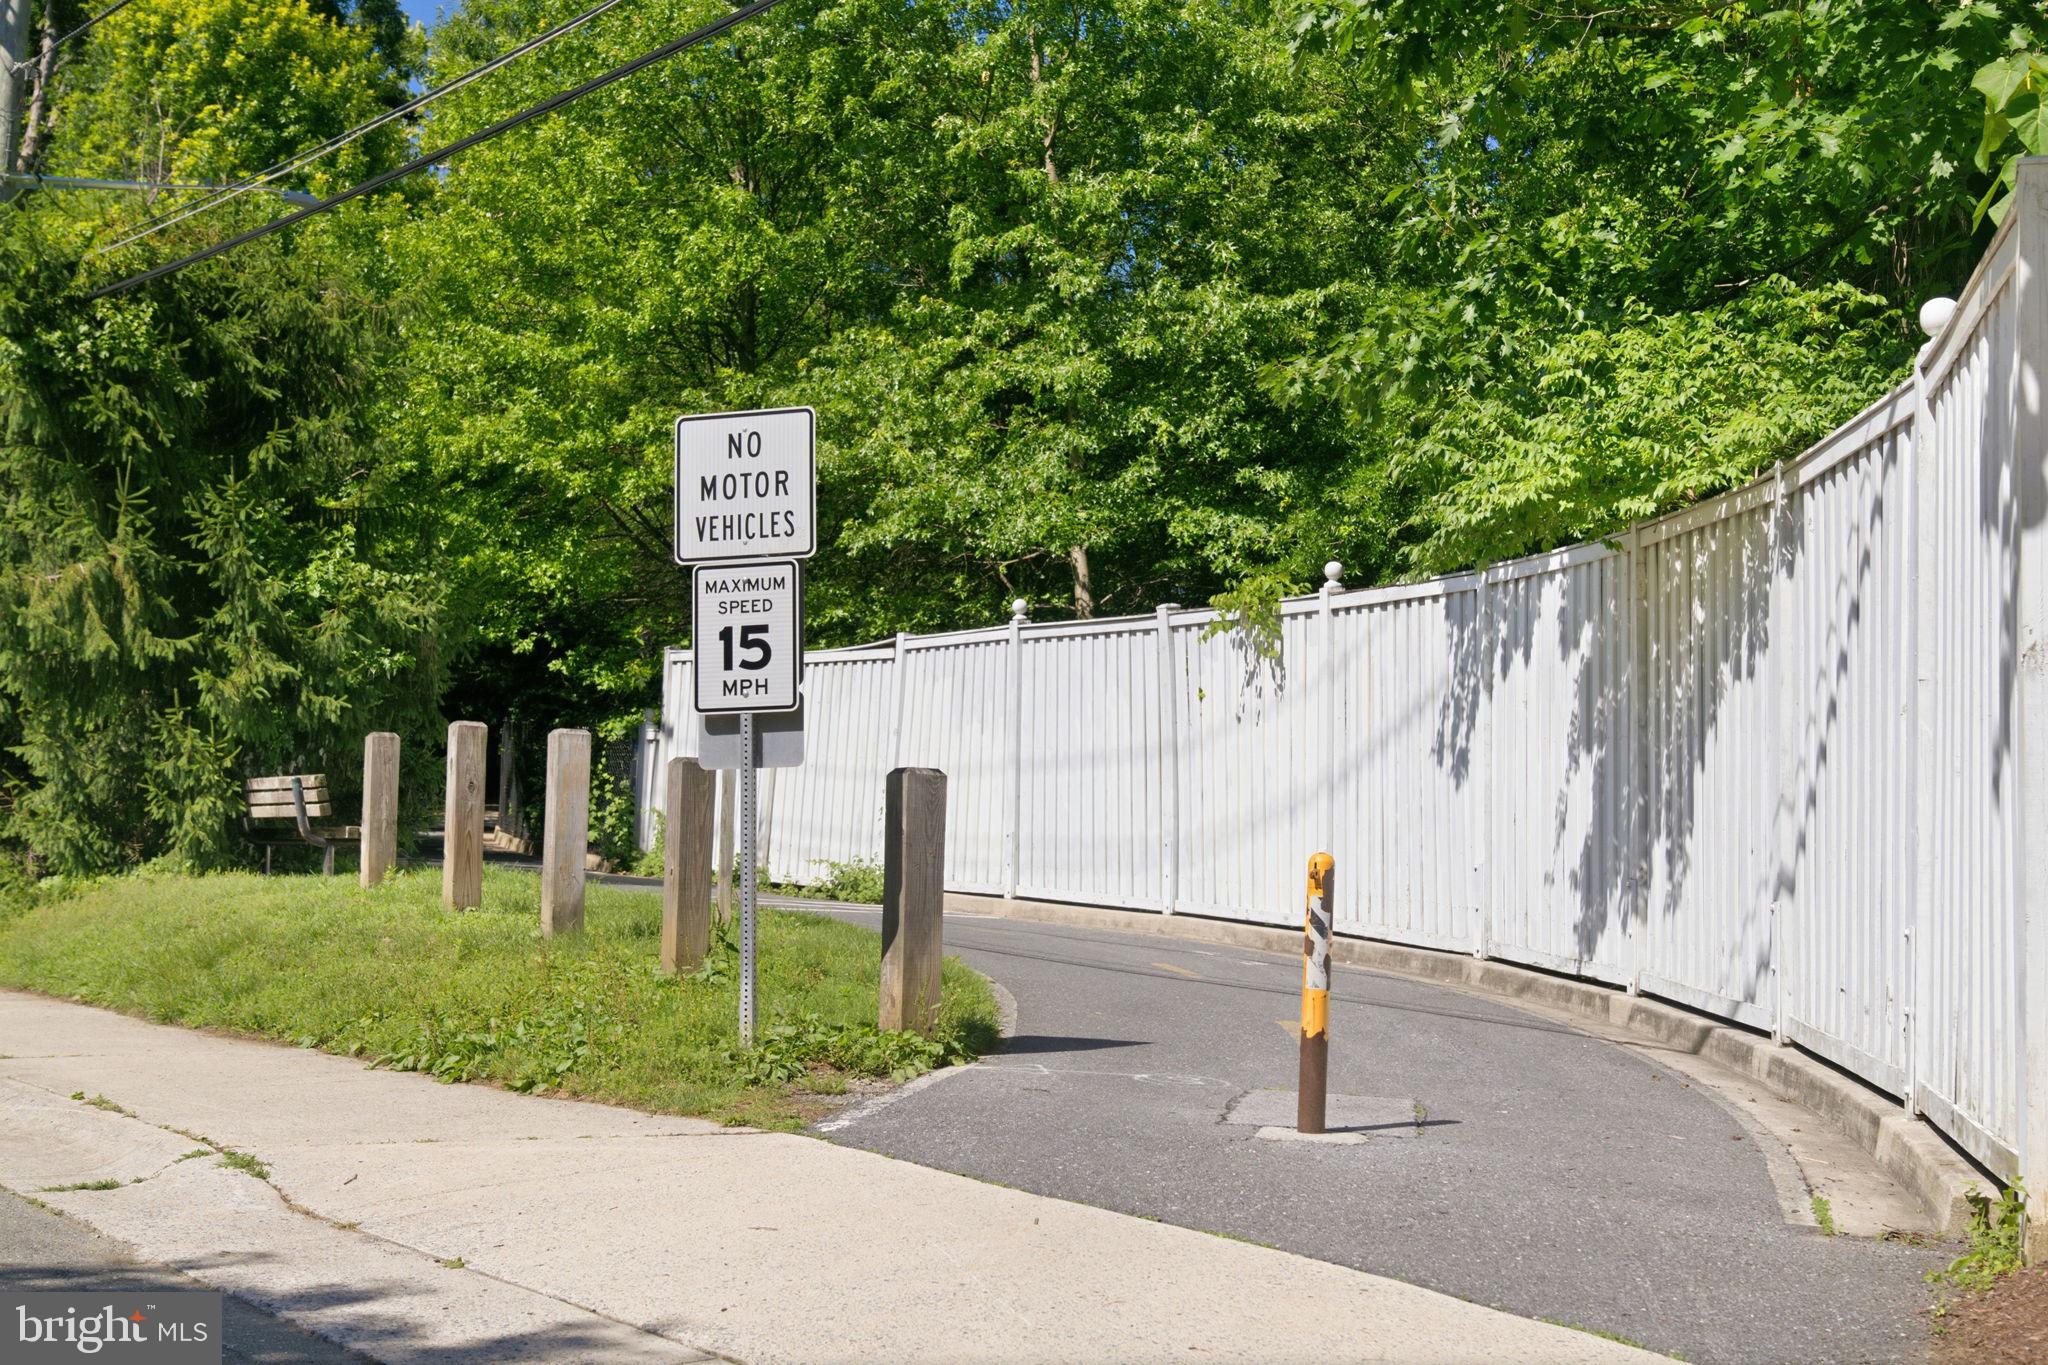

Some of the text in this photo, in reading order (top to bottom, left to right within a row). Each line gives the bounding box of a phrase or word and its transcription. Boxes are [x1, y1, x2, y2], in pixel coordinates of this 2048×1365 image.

[728, 431, 761, 459] NO
[700, 470, 789, 501] MOTOR
[695, 510, 795, 542] VEHICLES
[705, 576, 785, 594] MAXIMUM
[718, 599, 773, 614] SPEED
[719, 624, 772, 671] 15
[723, 678, 768, 696] MPH
